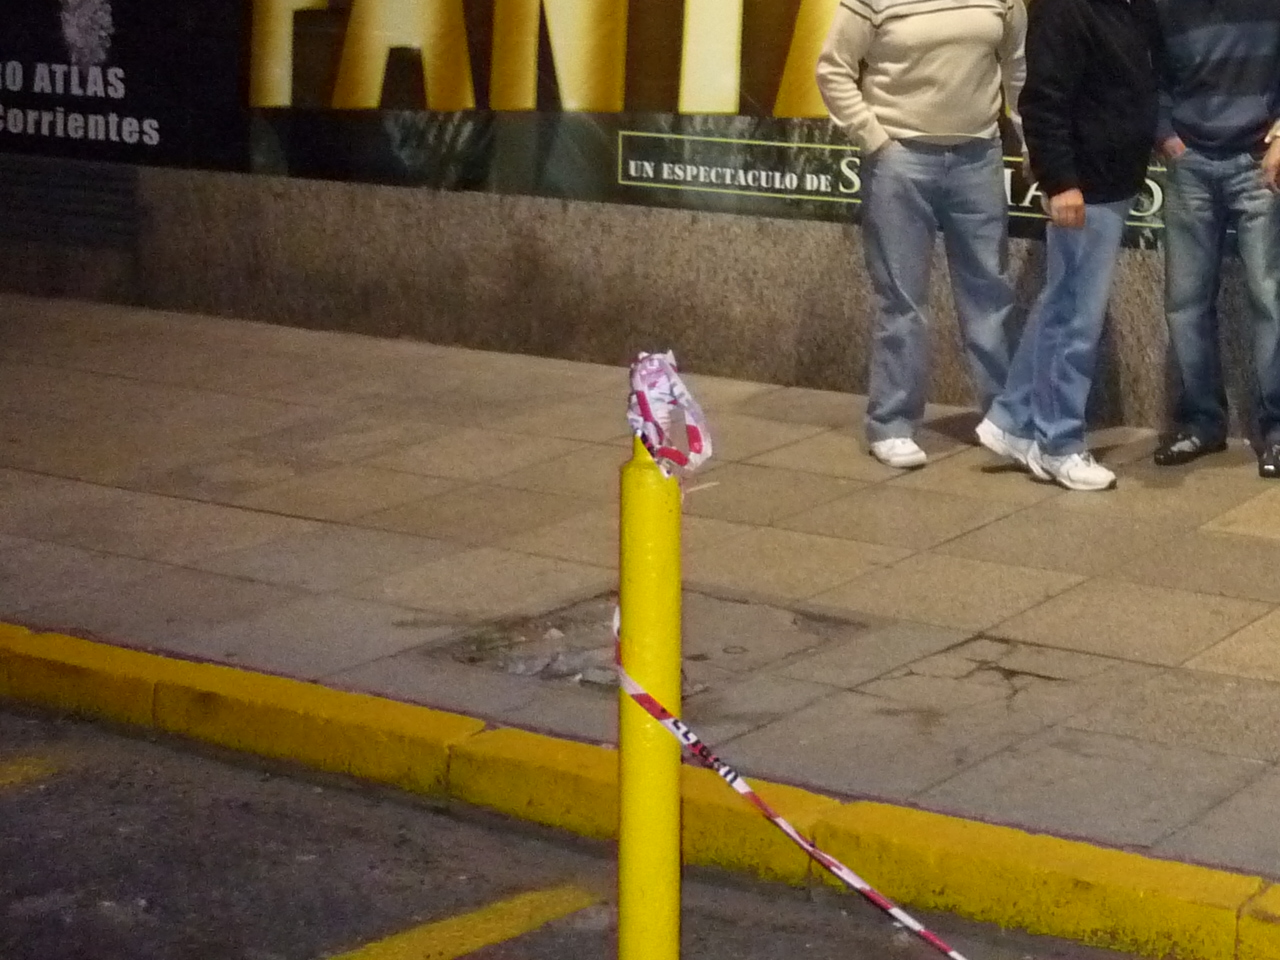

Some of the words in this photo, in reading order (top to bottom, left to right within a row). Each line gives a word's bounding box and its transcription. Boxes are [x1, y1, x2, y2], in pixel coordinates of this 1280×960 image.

[33, 62, 126, 99] ATLAS
[628, 159, 655, 179] UN
[662, 162, 798, 191] ESPECTACULO
[805, 172, 832, 193] DE
